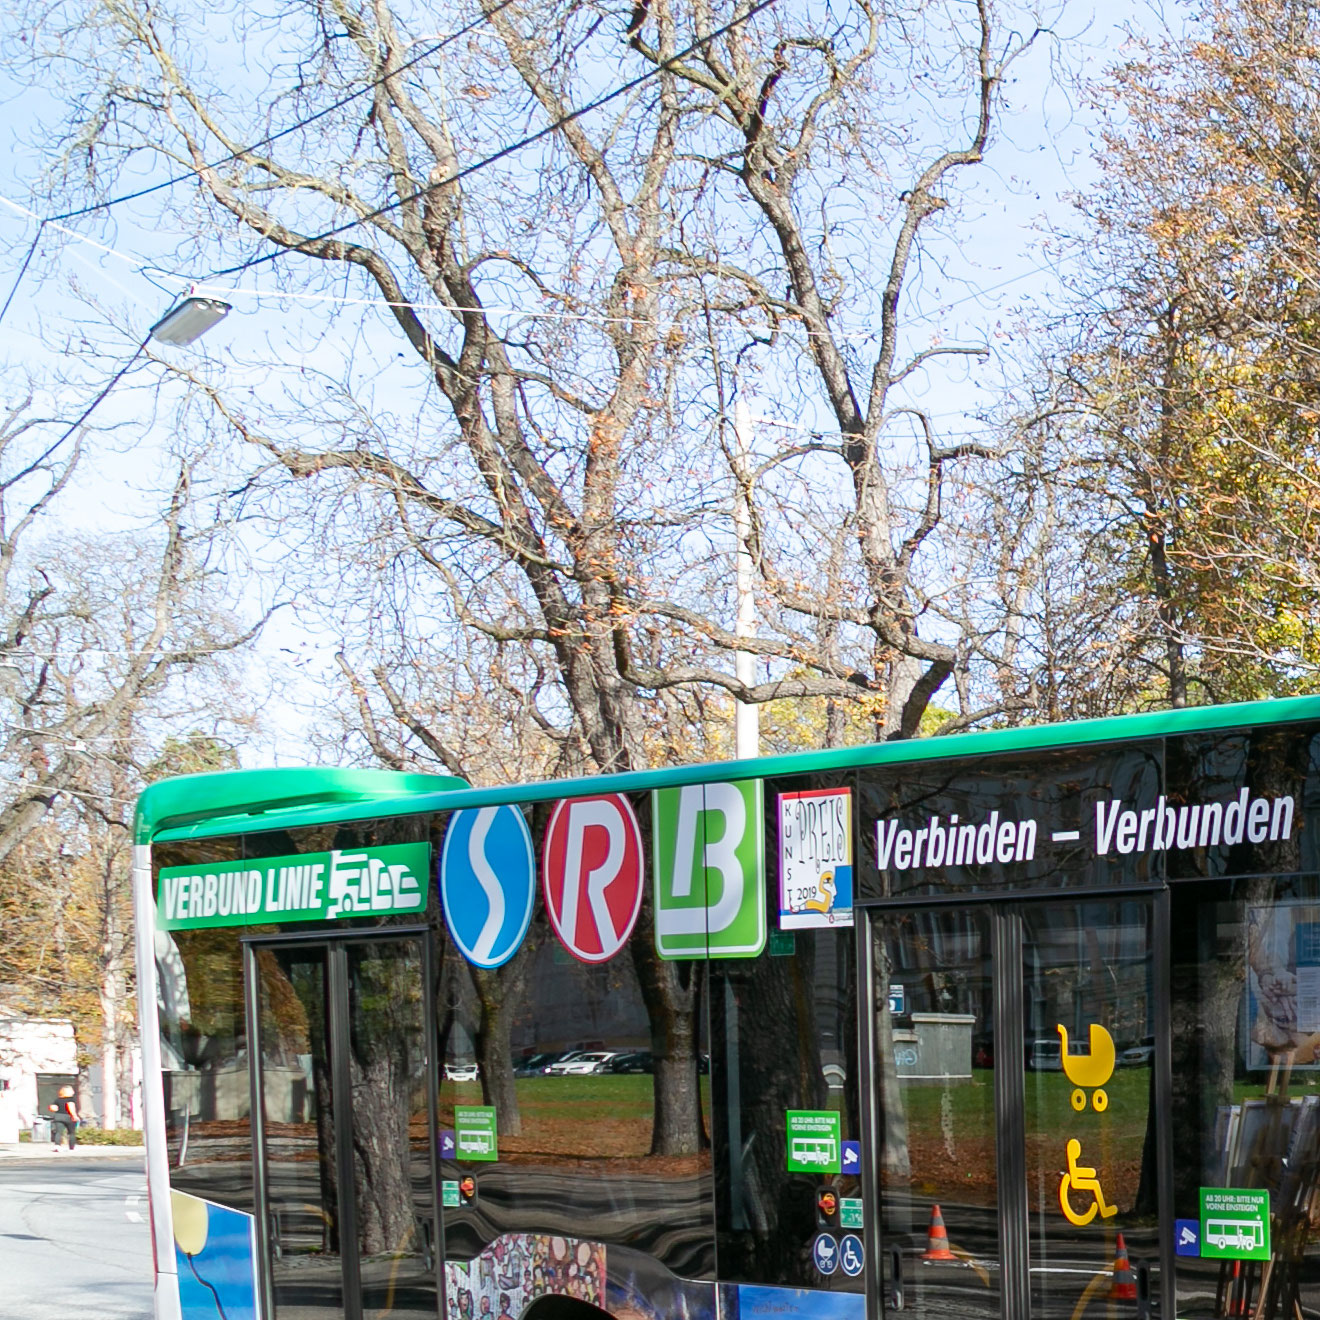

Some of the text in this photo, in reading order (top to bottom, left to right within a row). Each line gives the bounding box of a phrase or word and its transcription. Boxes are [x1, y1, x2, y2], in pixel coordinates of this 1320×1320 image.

[659, 782, 746, 936] B
[795, 797, 847, 875] PREIS
[876, 810, 1038, 872] Verbinden
[1095, 786, 1295, 856] Verbunden
[163, 863, 325, 920] VERBUND LINIE
[560, 799, 626, 954] R
[797, 886, 818, 901] 2019
[1205, 1194, 1213, 1202] AB
[1236, 1195, 1250, 1203] BITTE
[1250, 1196, 1264, 1204] NUR
[1205, 1203, 1258, 1212] VORNE EINSTEIGEN
